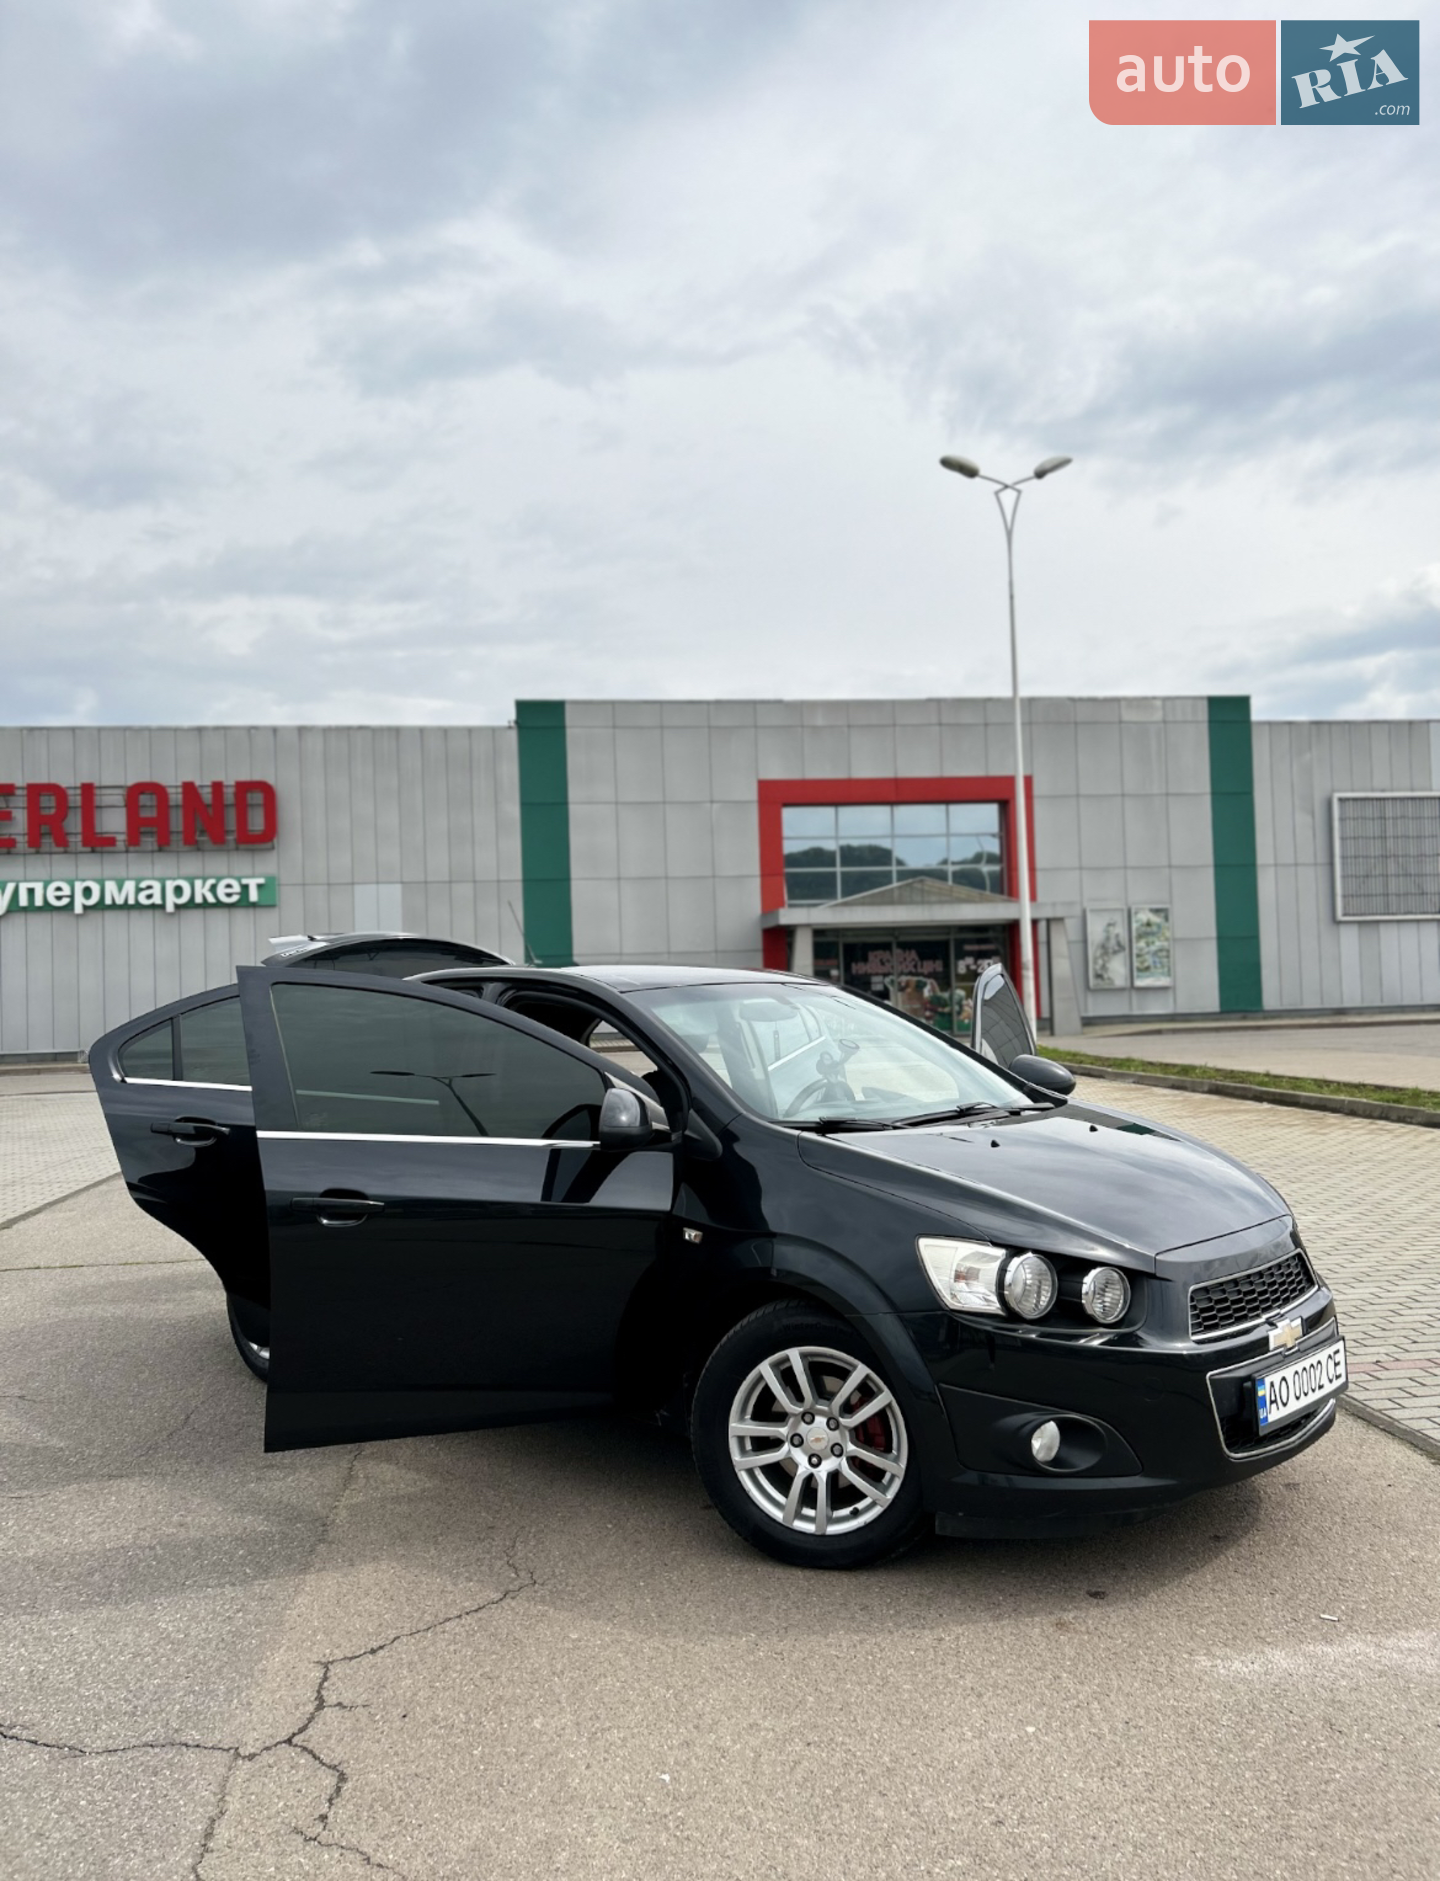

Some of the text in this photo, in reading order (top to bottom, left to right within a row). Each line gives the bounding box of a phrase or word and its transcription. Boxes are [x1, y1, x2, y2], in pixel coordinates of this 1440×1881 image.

[0, 877, 265, 916] упермаркет
[1268, 1348, 1343, 1414] AO 0002 CE
